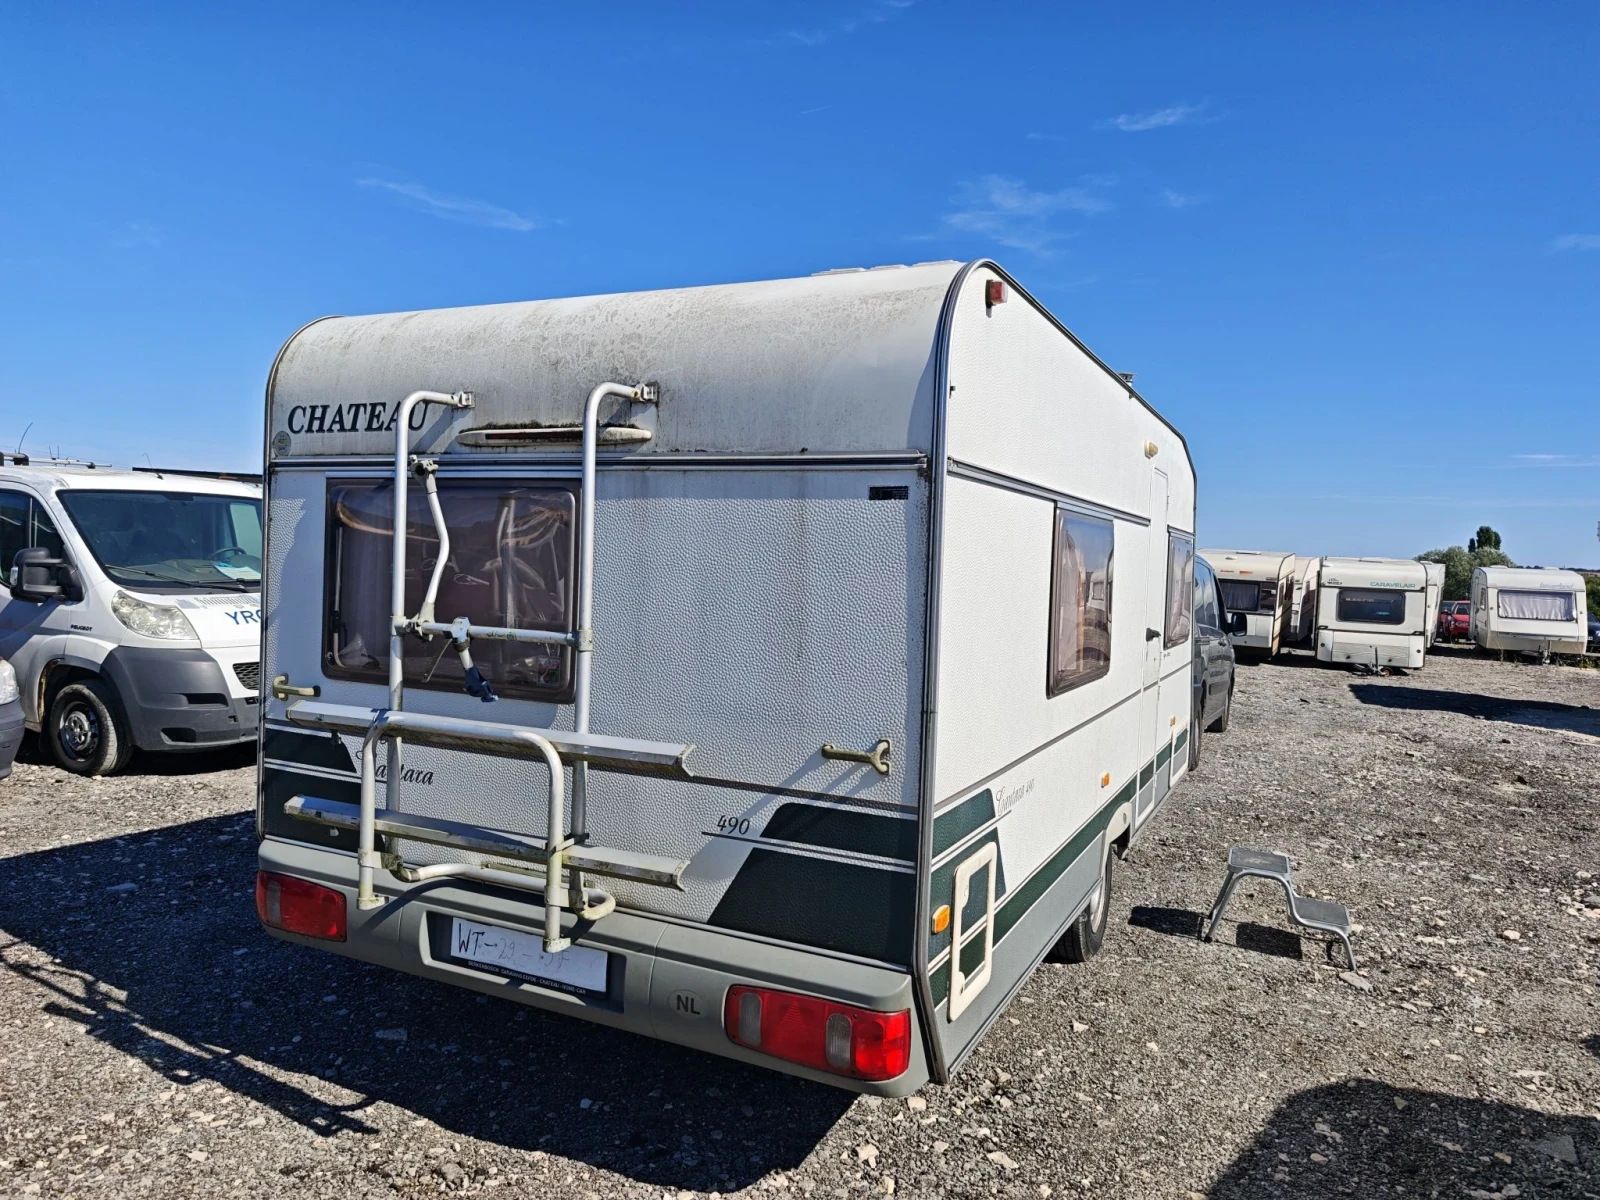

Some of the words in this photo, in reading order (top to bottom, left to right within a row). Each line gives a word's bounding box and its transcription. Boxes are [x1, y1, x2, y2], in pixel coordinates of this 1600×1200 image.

[1370, 581, 1416, 589] CARAVELAIR
[716, 814, 750, 835] 490
[500, 968, 523, 979] CARAVANS
[540, 978, 560, 988] CHATEAU
[676, 994, 701, 1016] NL
